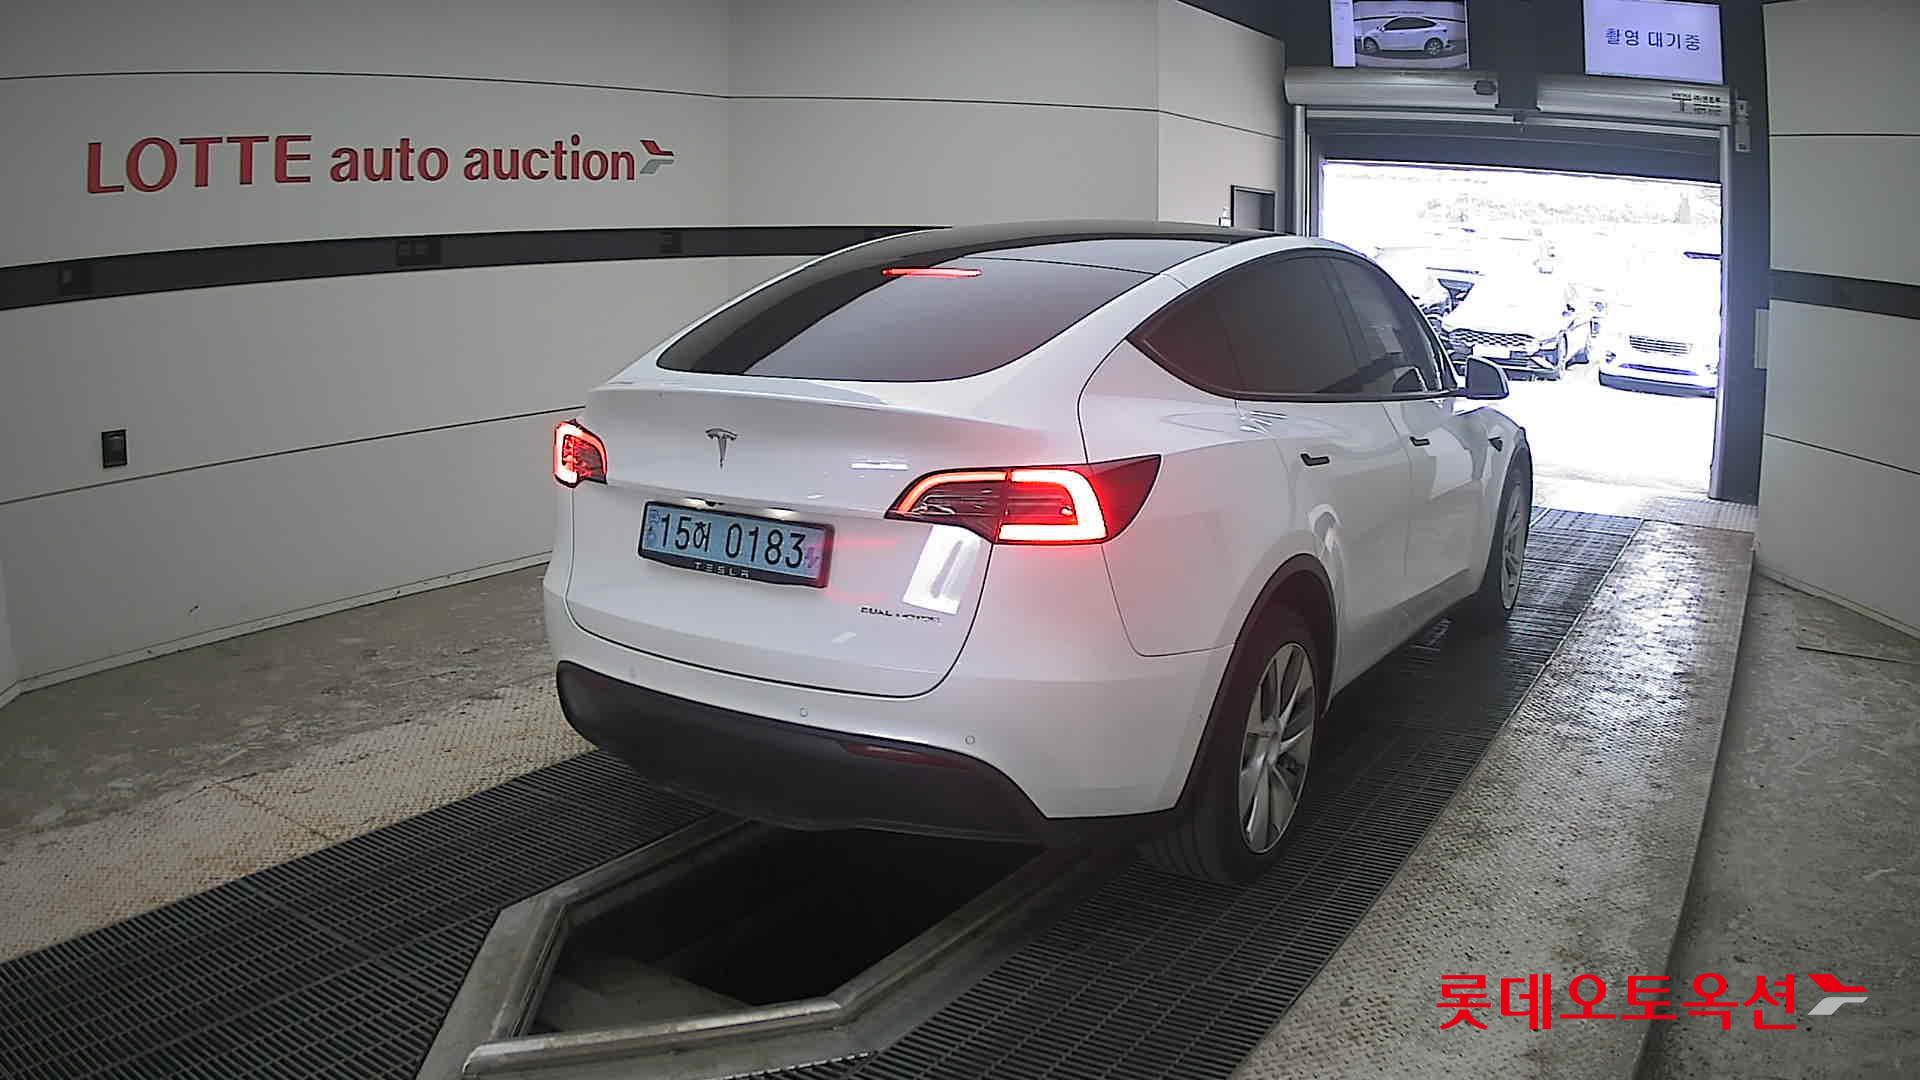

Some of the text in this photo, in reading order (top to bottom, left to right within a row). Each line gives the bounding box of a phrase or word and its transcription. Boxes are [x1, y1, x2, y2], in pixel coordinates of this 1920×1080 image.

[1647, 31, 1701, 51] 대기중
[87, 134, 637, 194] LOTTE auto auction
[661, 513, 712, 553] 15허
[725, 522, 806, 568] 0183
[694, 561, 750, 578] TESLA
